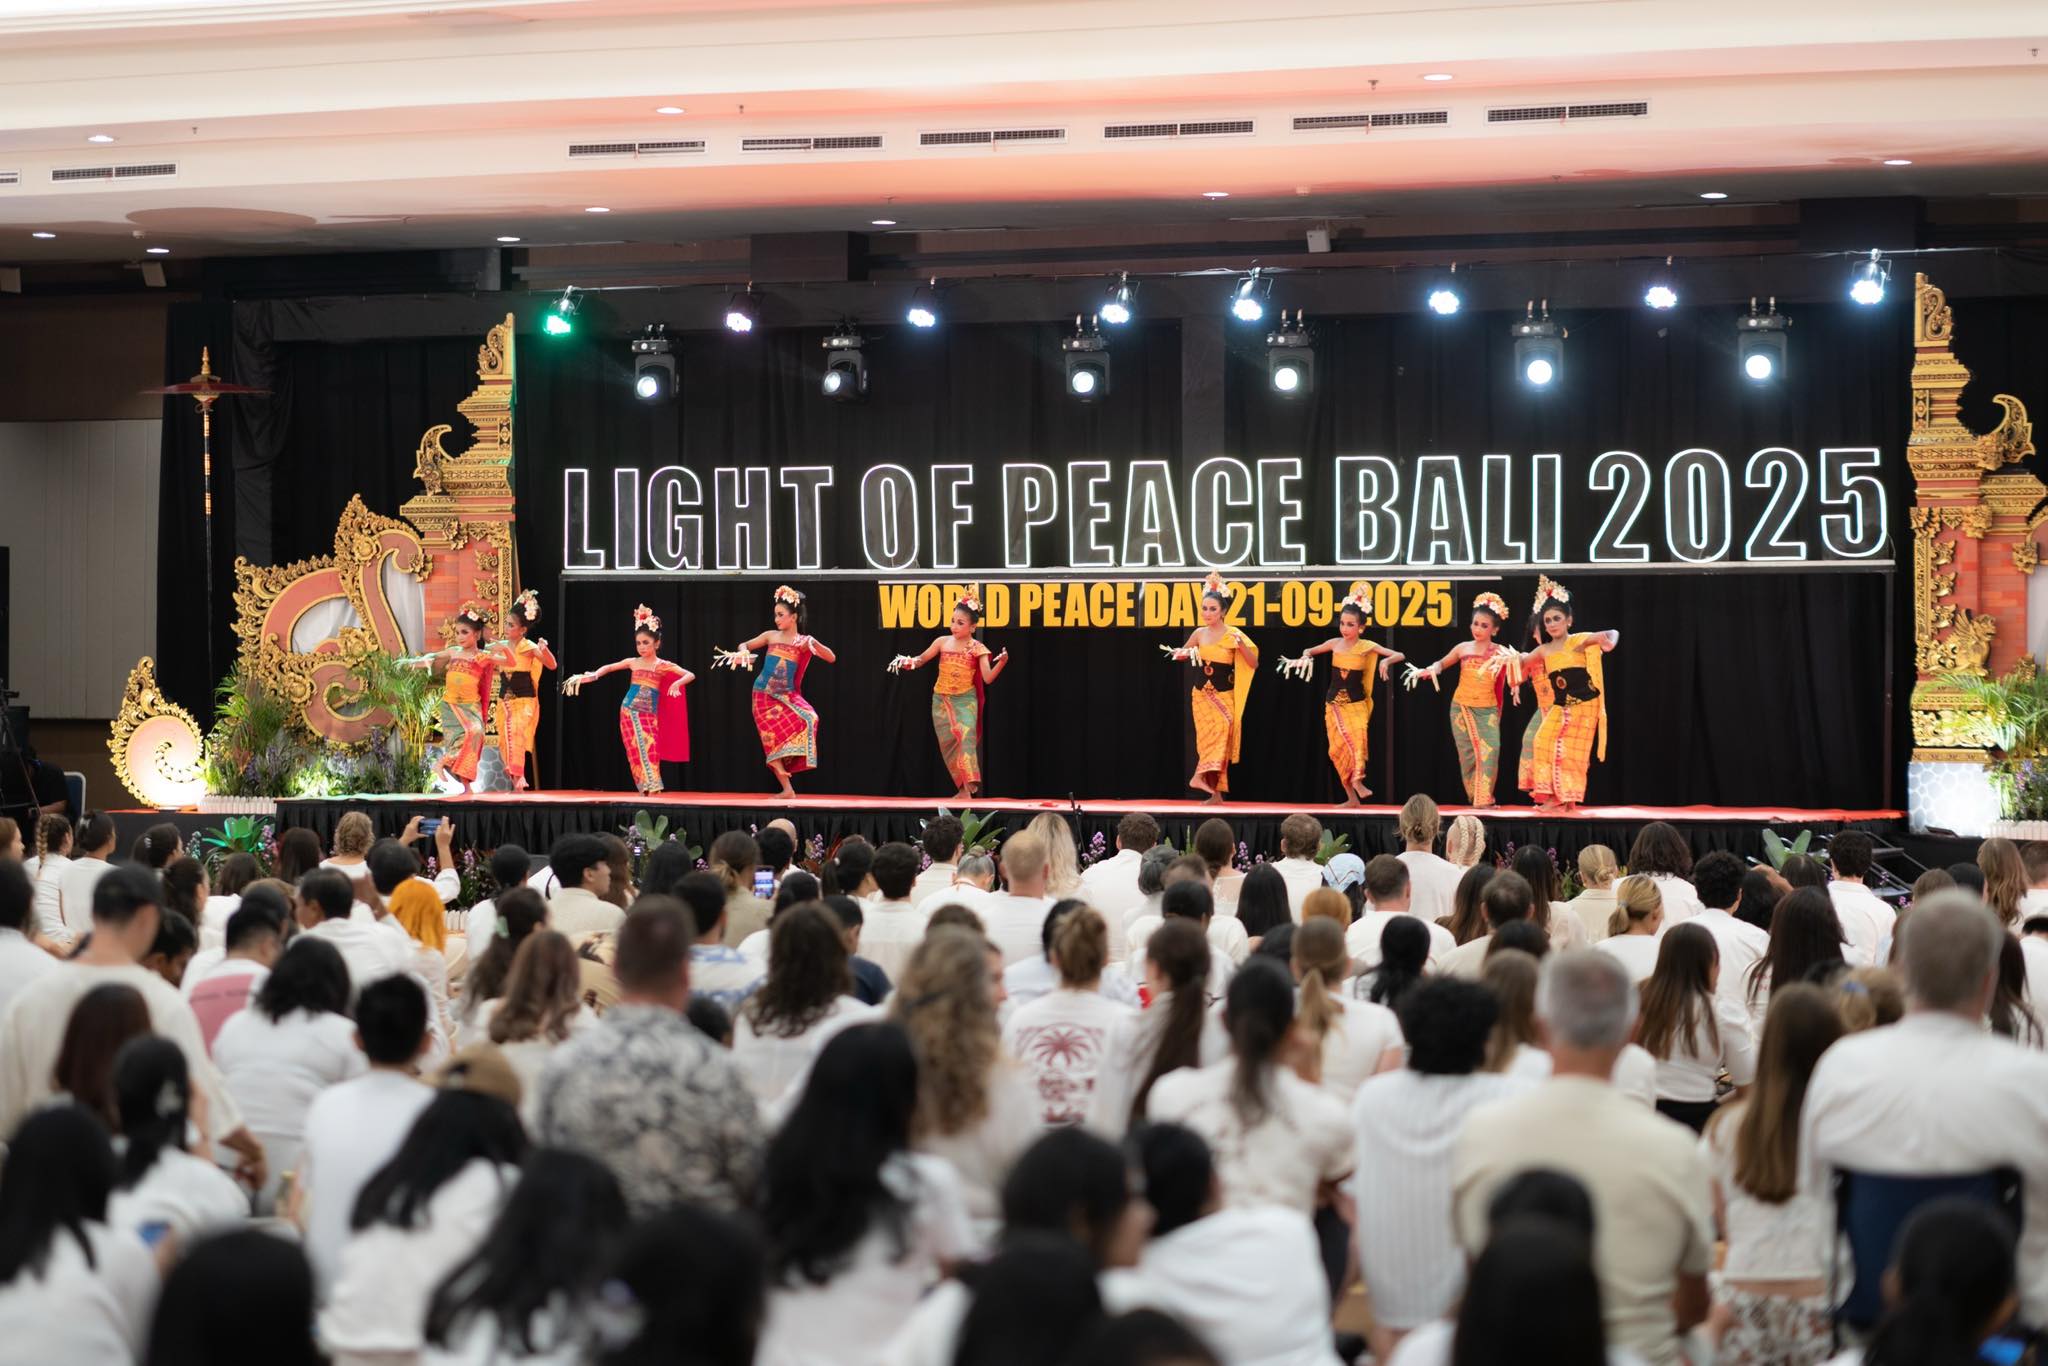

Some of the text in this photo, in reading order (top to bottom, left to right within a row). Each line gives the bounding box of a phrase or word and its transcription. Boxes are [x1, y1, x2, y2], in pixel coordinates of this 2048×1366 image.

[564, 447, 1888, 571] LIGHT OF PEACE BALI 2025
[1019, 582, 1136, 628] PEACE
